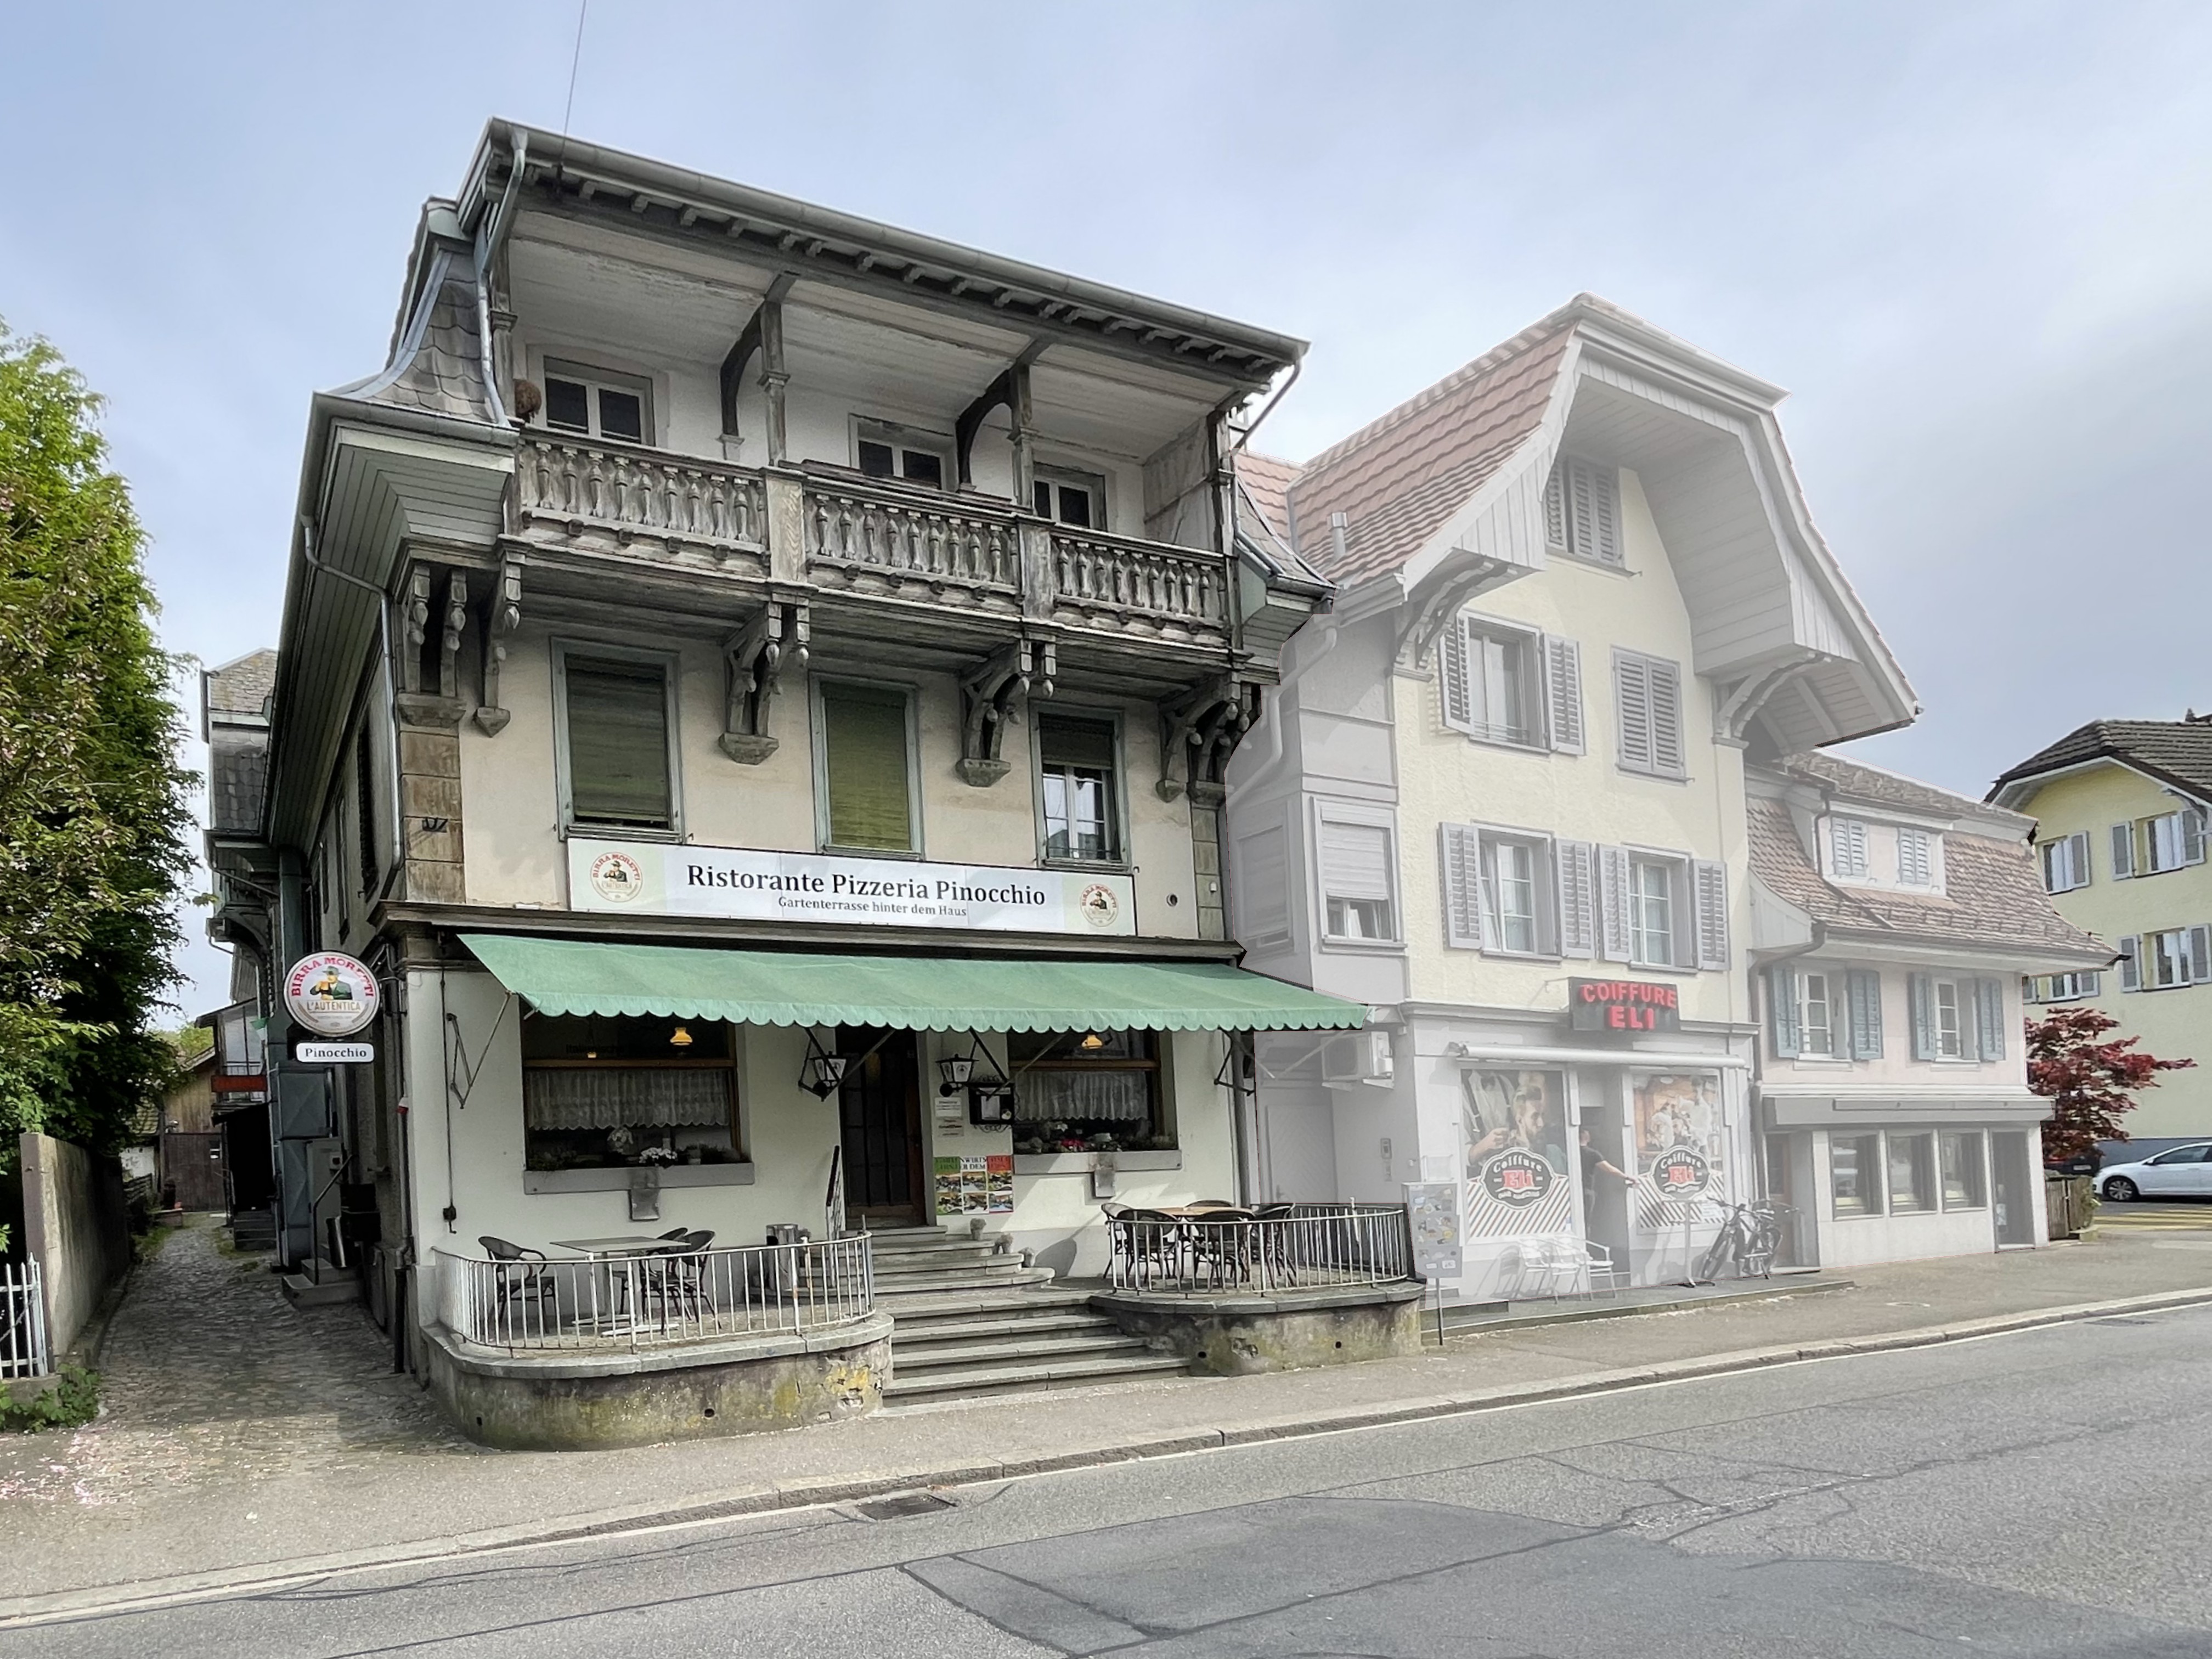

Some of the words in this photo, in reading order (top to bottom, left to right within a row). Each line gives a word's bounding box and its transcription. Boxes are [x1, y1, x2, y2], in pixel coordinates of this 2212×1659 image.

[592, 855, 611, 878] BIRRA
[612, 854, 641, 881] MORETTI
[687, 865, 825, 893] Ristorante
[832, 874, 929, 899] Pizzeria
[936, 881, 1045, 906] Pinocchio
[778, 896, 870, 912] Gartenterrasse
[872, 901, 907, 914] hinter
[911, 903, 936, 915] dem
[939, 905, 967, 917] Haus
[291, 960, 322, 997] BIRRA
[324, 957, 374, 997] MORETTI
[306, 1000, 362, 1011] L'AUTENTICA
[1581, 982, 1677, 1009] COIFFURE
[1609, 1006, 1655, 1030] ELI
[304, 1047, 367, 1058] Pinocchio
[1493, 1154, 1543, 1173] Coiffure
[1660, 1152, 1702, 1169] Coiffure
[1503, 1169, 1535, 1189] Eli
[1668, 1165, 1695, 1183] Eli
